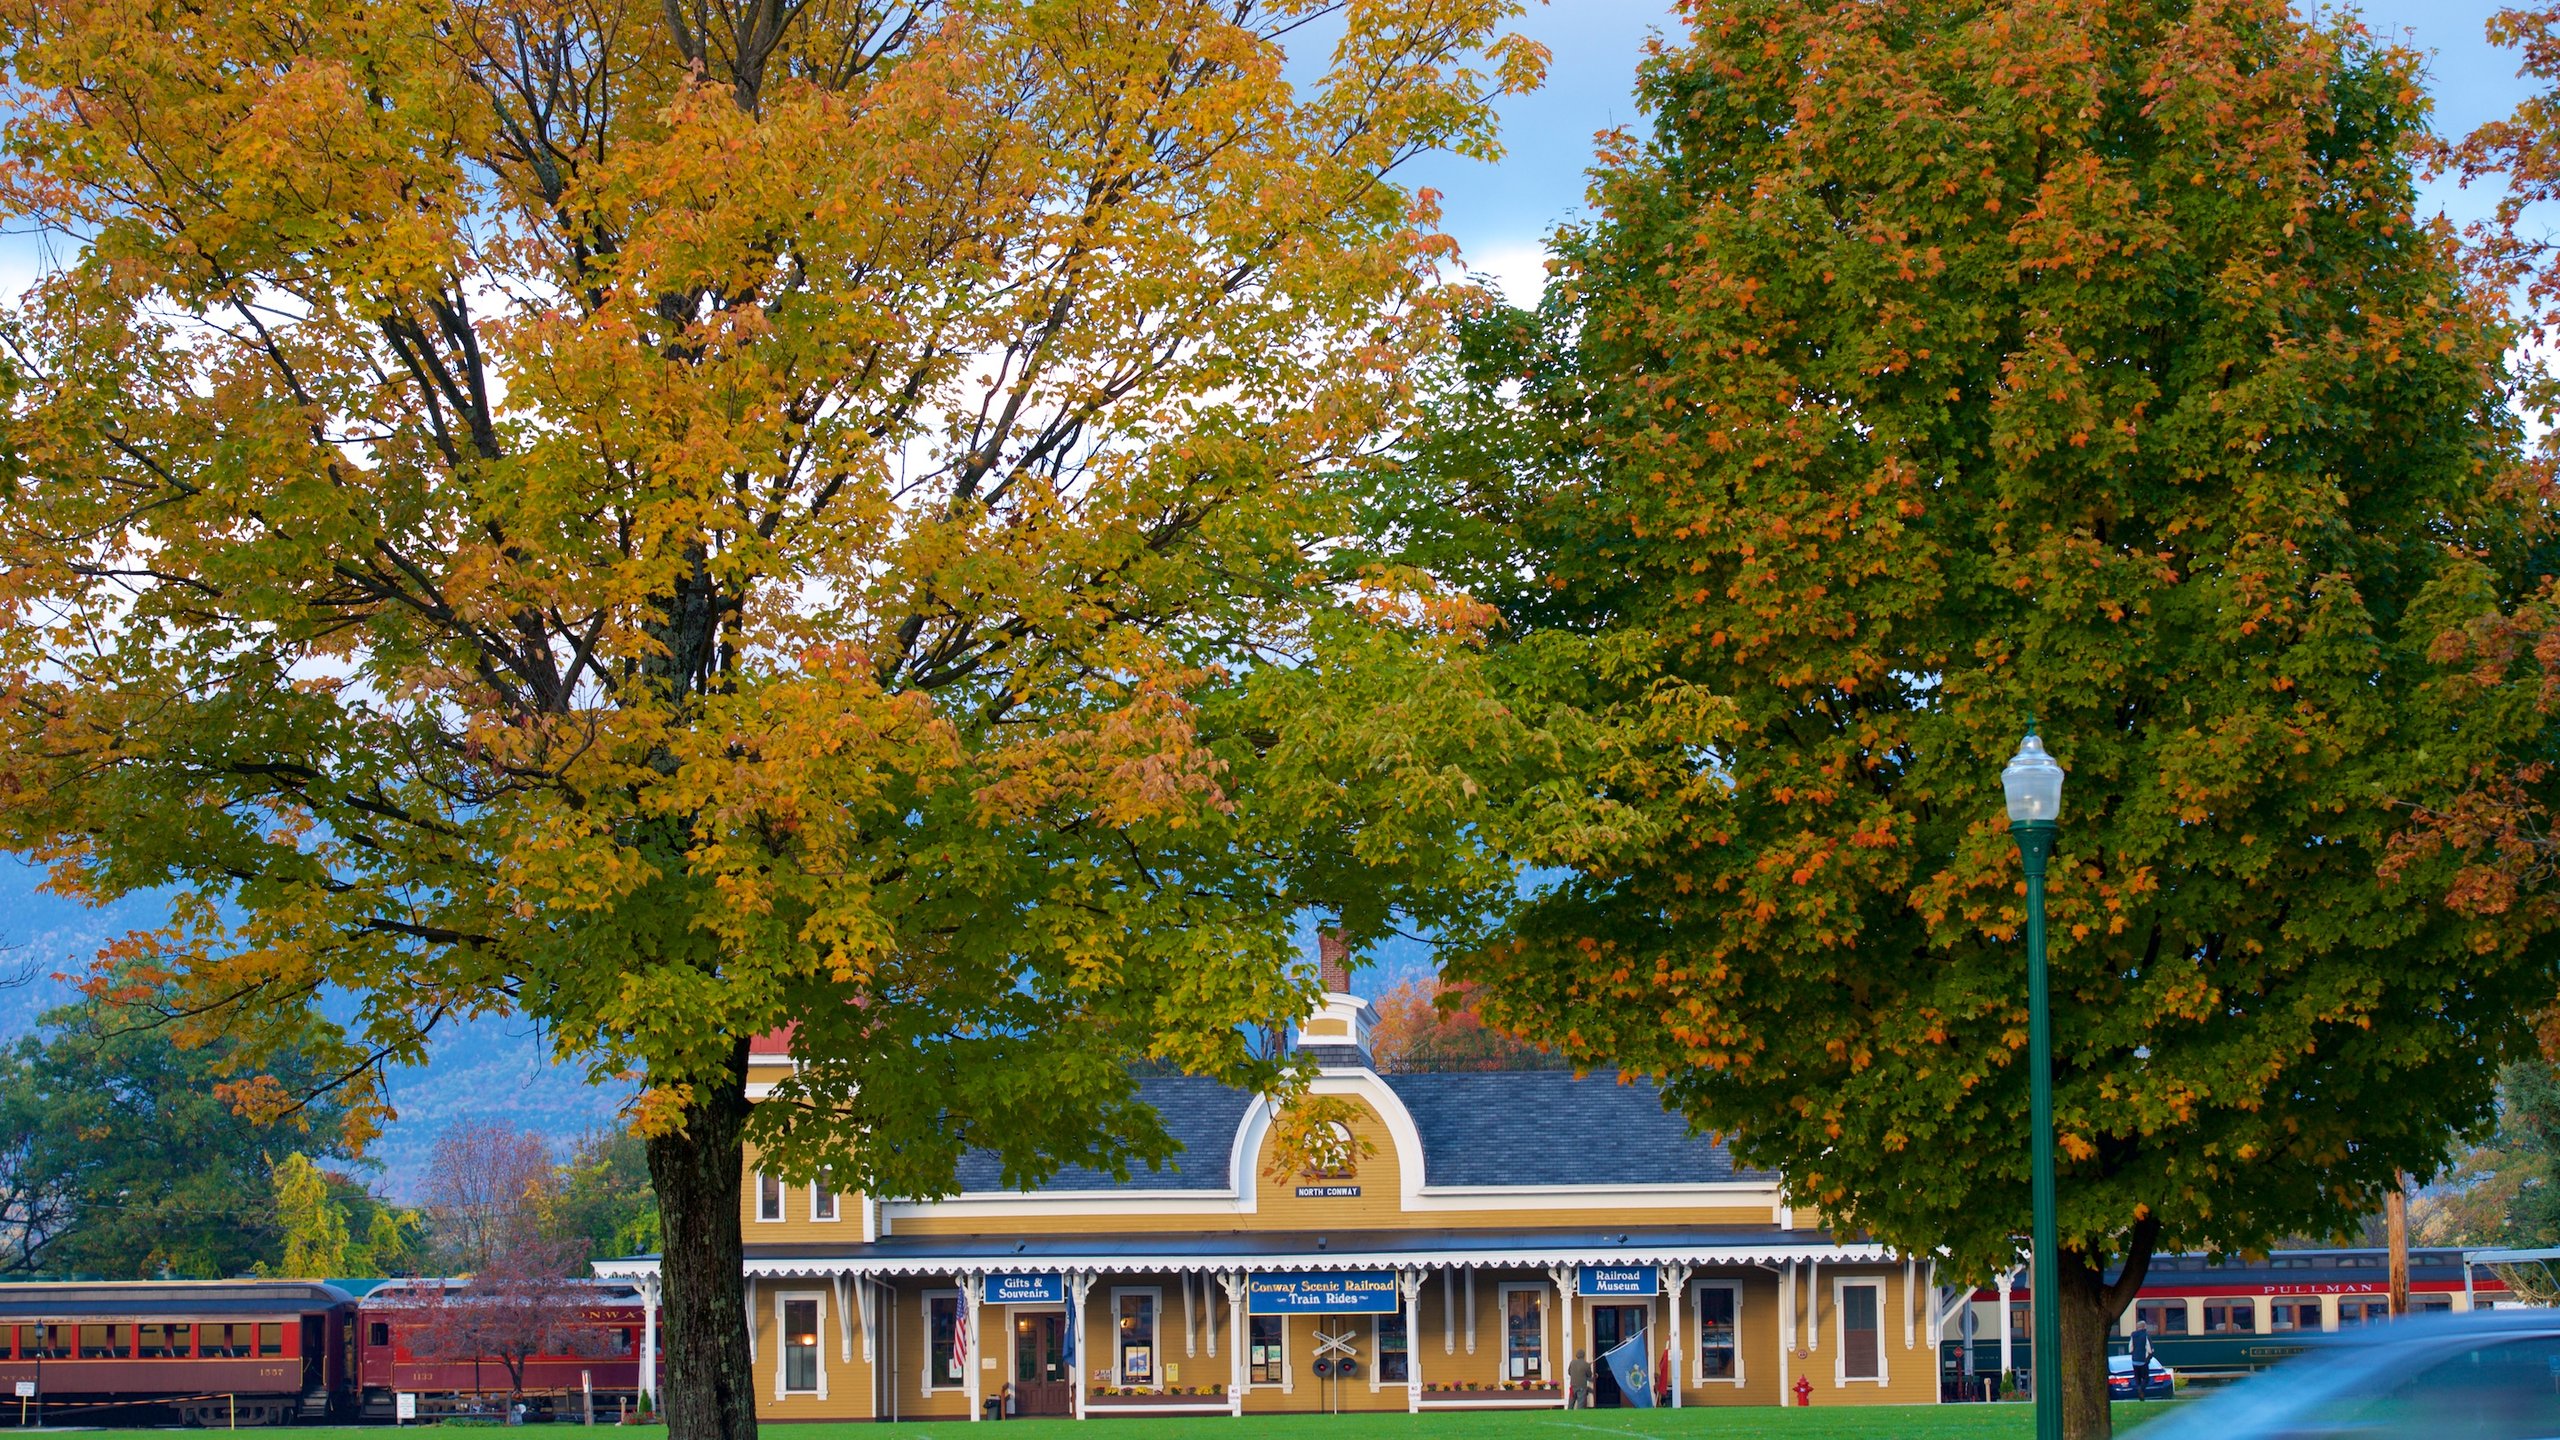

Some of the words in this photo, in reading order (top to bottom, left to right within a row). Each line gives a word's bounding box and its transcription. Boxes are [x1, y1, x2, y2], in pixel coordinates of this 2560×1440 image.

[1298, 1188, 1324, 1196] NORTH
[1327, 1187, 1358, 1196] CONWAY
[1596, 1270, 1640, 1280] Railroad
[1004, 1278, 1030, 1288] Gifts
[1034, 1278, 1042, 1288] &
[1250, 1281, 1296, 1293] Conway
[1301, 1280, 1340, 1292] Scenic
[1344, 1279, 1394, 1291] Railroad
[1596, 1281, 1640, 1291] Museum
[998, 1288, 1050, 1299] Souvenirs
[2264, 1284, 2372, 1293] PULLMAN
[1289, 1293, 1320, 1304] Train
[1326, 1292, 1357, 1303] Rides
